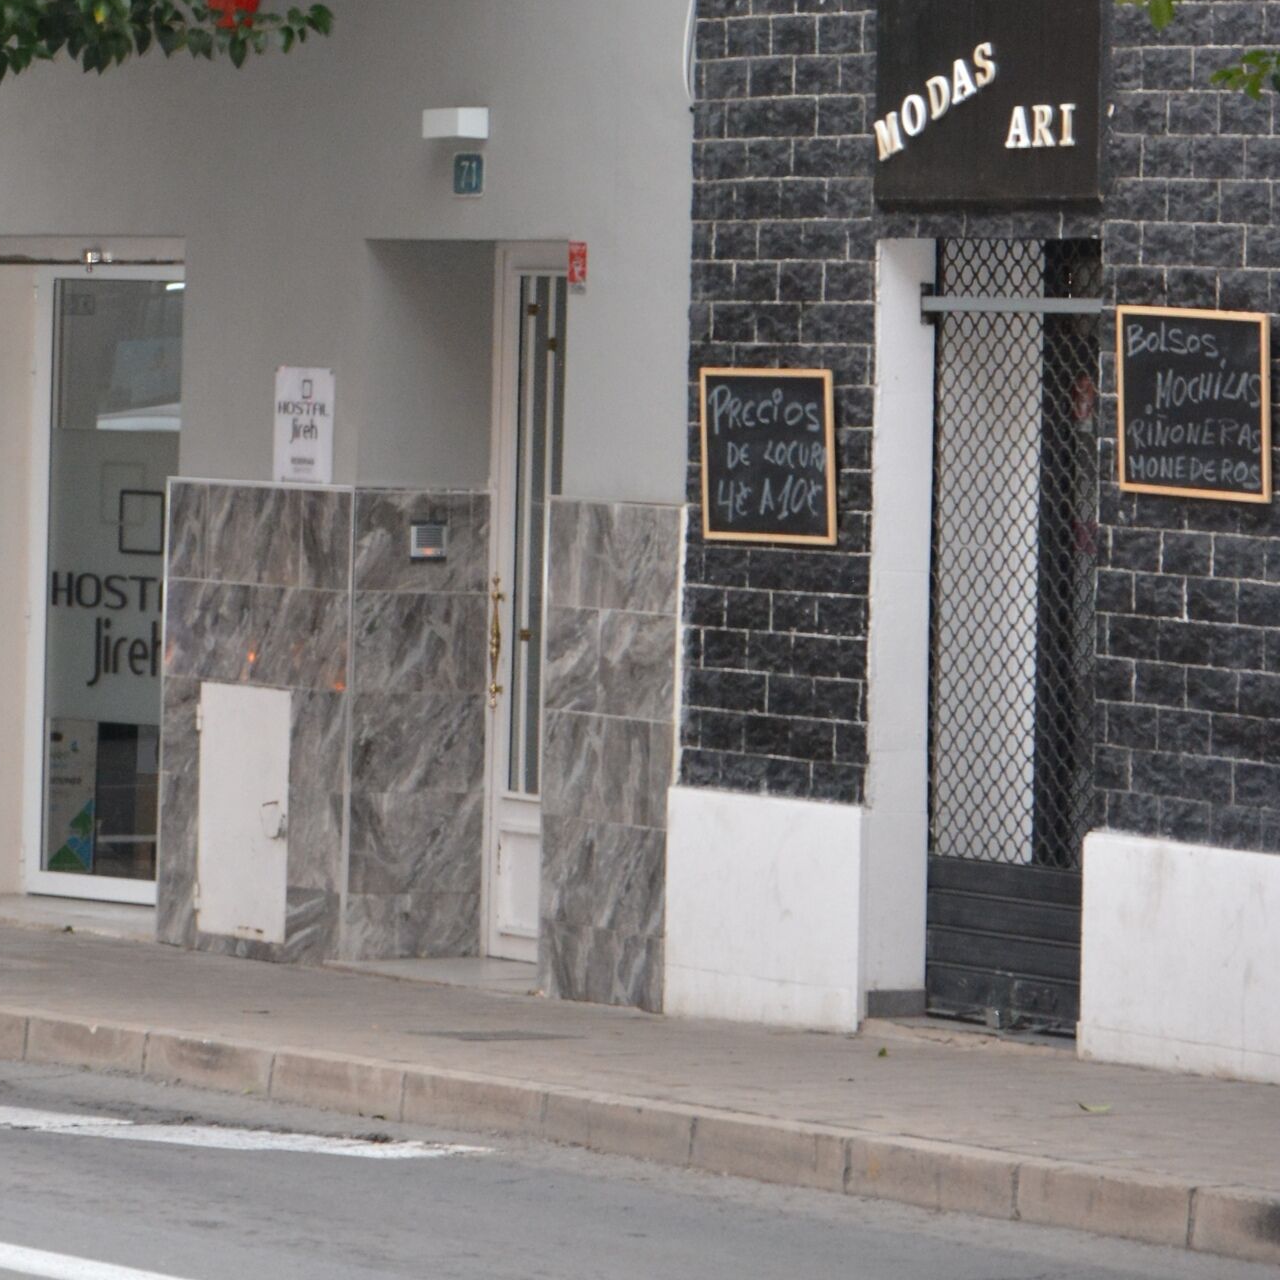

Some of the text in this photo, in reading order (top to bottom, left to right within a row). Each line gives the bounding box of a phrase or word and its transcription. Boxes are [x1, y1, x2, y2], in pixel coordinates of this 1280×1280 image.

[873, 42, 997, 162] MODAS
[1004, 103, 1077, 149] ARI
[460, 160, 477, 189] 71
[278, 401, 330, 417] HOSTAL
[726, 441, 751, 470] DE
[1129, 454, 1261, 490] MONEDEROS
[51, 571, 163, 613] HOST
